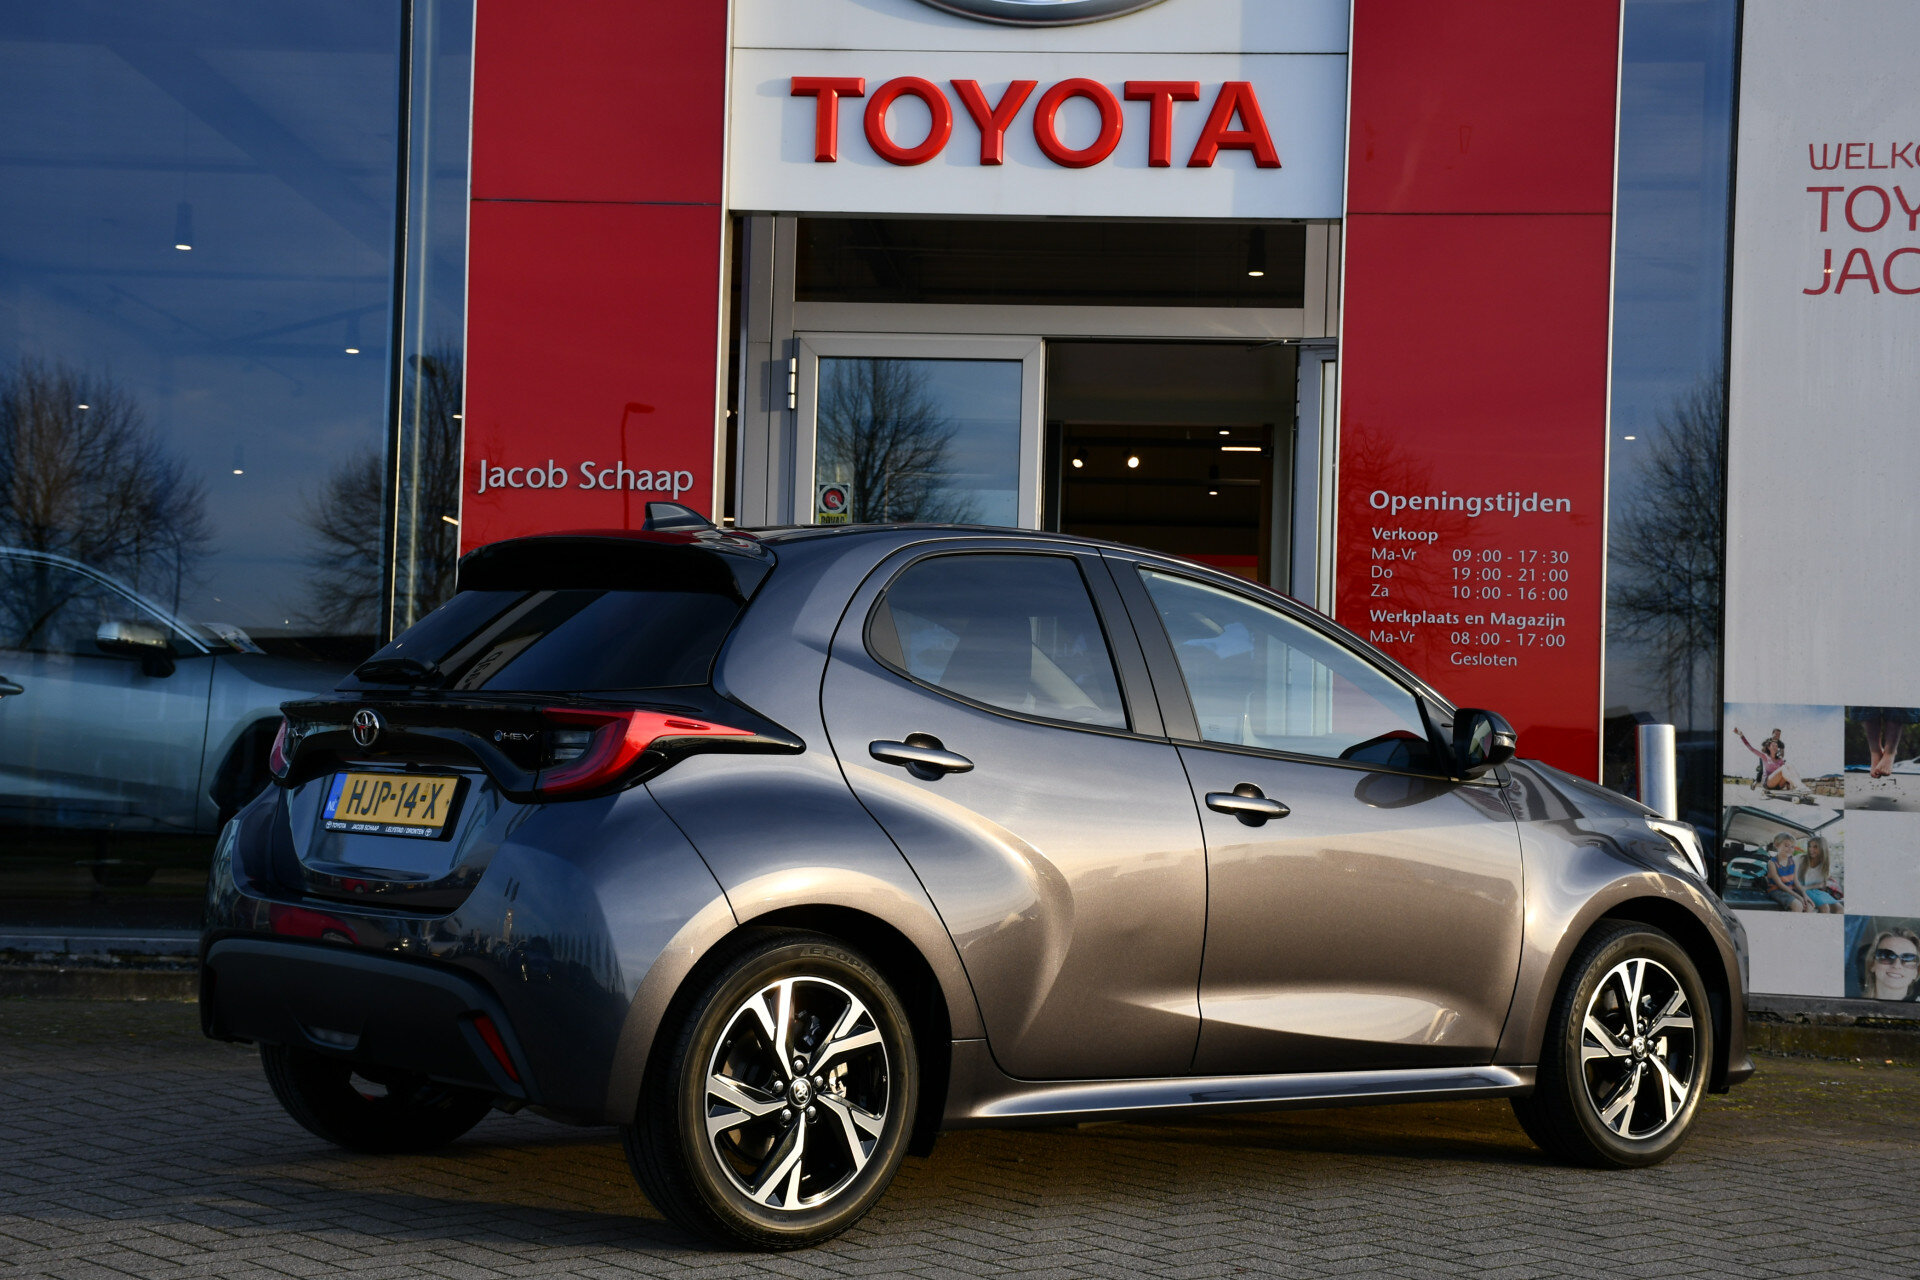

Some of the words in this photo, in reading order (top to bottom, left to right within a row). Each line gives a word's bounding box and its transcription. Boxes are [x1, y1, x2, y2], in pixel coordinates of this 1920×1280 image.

[791, 76, 1282, 168] TOYOTA
[478, 459, 569, 494] Jacob
[578, 460, 694, 500] Schaap
[1369, 490, 1571, 518] Openingstijden
[1371, 527, 1439, 545] Verkoop
[1371, 547, 1417, 561] Ma-Vr
[1371, 565, 1393, 579] Do
[1370, 584, 1389, 597] Za
[1369, 609, 1459, 627] Werkplaats
[1464, 614, 1485, 625] en
[1490, 612, 1566, 630] Magazijn
[1370, 630, 1415, 643] Ma-Vr
[1450, 651, 1518, 667] Gesloten
[326, 800, 337, 812] NL
[346, 779, 445, 819] HJP-14-X
